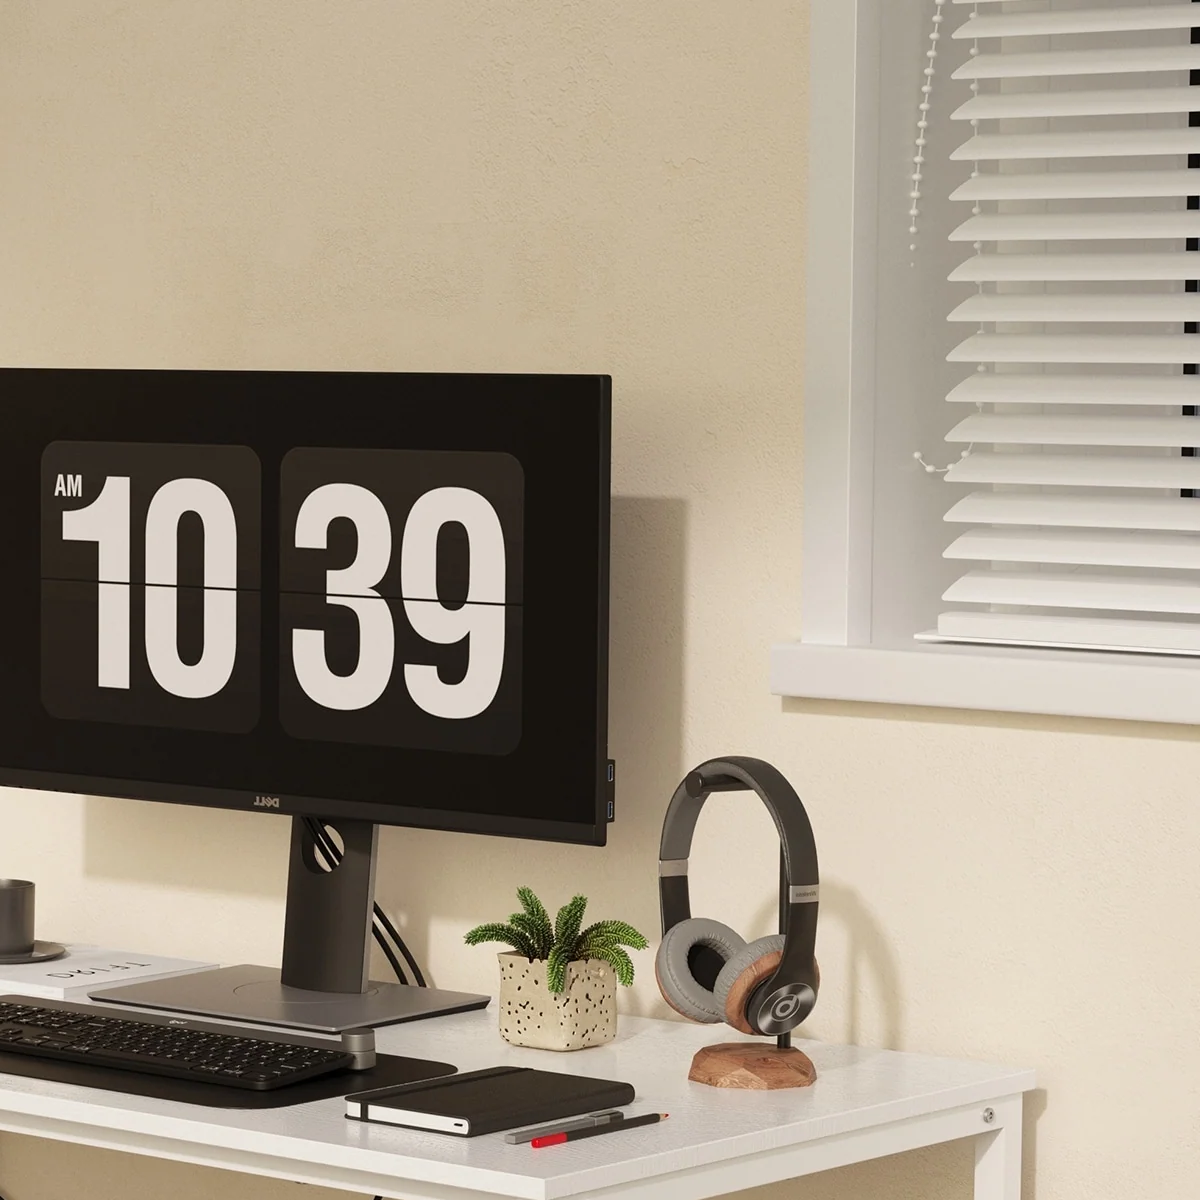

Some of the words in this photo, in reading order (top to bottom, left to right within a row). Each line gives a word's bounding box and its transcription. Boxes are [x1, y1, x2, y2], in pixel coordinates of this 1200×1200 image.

[54, 474, 83, 497] AM
[62, 476, 237, 699] 10
[292, 482, 506, 719] 39
